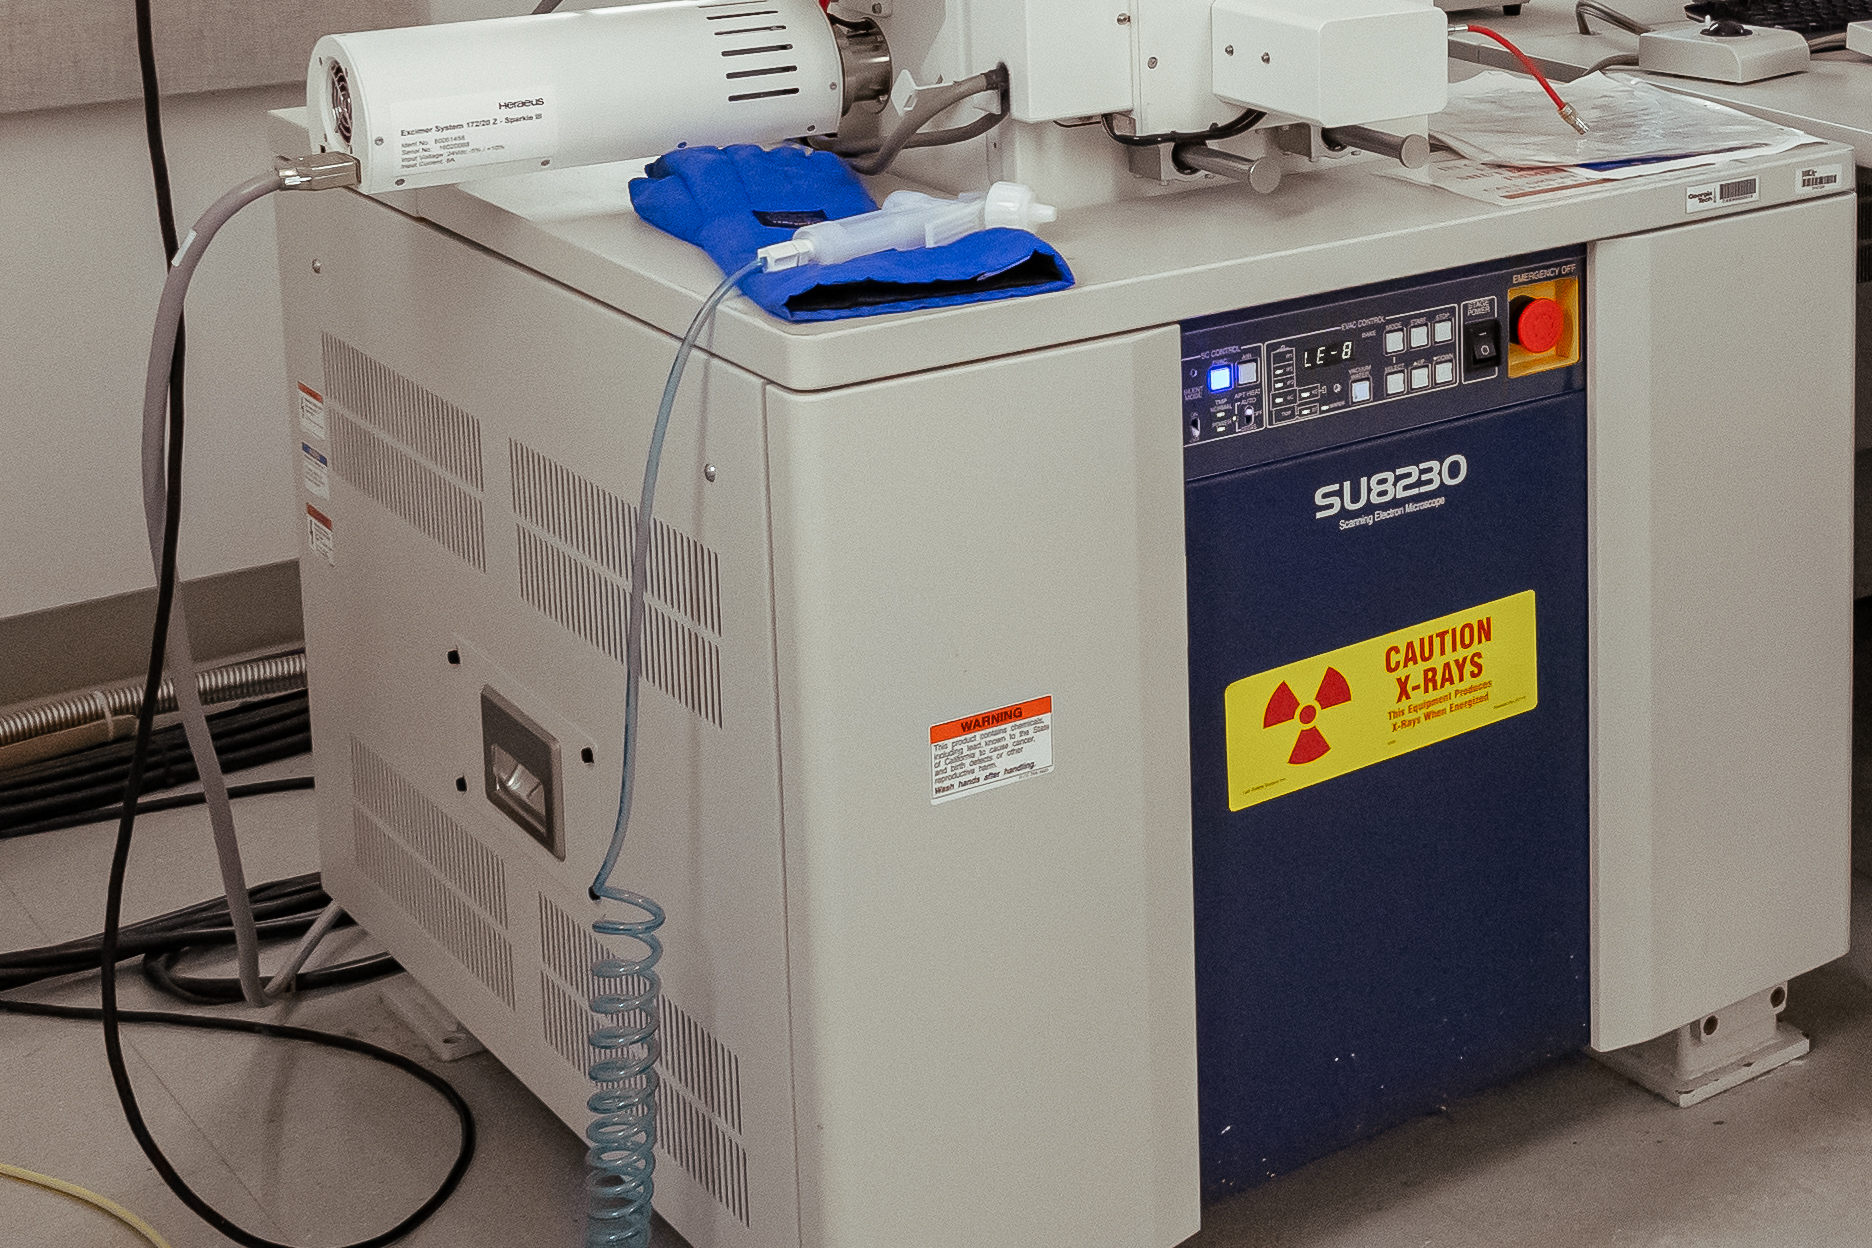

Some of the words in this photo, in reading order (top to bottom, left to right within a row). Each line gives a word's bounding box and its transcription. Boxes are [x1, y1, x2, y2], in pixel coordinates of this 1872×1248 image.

[498, 97, 544, 110] Heraeus
[400, 126, 433, 137] Excimer
[434, 122, 464, 133] System
[504, 114, 534, 124] Sparkle
[1688, 190, 1712, 200] Georgia
[1512, 268, 1560, 284] EMERGENCY
[1561, 264, 1576, 274] OFF
[1342, 321, 1356, 330] EVAC
[1358, 316, 1386, 327] CONTROL
[1467, 306, 1490, 316] POWER
[1200, 351, 1210, 360] SC
[1210, 346, 1241, 358] CONTROL
[1184, 392, 1202, 400] MODE
[1240, 397, 1256, 405] AUTO
[1314, 454, 1468, 520] SU8230
[1338, 515, 1374, 530] Scanning
[1374, 506, 1404, 522] Electron
[1405, 497, 1446, 514] Microscope
[1385, 616, 1492, 674] CAUTION
[1396, 652, 1484, 704] X-RAYS
[1388, 708, 1406, 720] This
[1408, 692, 1452, 714] Equipment
[1454, 680, 1492, 698] Produces
[1392, 716, 1421, 732] X-Rays
[1423, 708, 1446, 722] When
[1450, 692, 1489, 712] Energized
[961, 707, 1023, 732] WARNING
[934, 744, 948, 752] This
[952, 734, 976, 750] product
[980, 728, 1007, 740] contains
[934, 748, 964, 760] including
[984, 736, 1006, 747] known
[1019, 730, 1030, 738] the
[1032, 724, 1050, 734] State
[934, 760, 942, 768] of
[944, 753, 976, 766] California
[989, 744, 1008, 754] cause
[1012, 736, 1036, 747] cancer,
[934, 767, 948, 776] and
[950, 762, 966, 772] birth
[969, 756, 993, 767] defects
[1006, 746, 1024, 756] other
[934, 768, 975, 784] reproductive
[934, 782, 954, 794] Wash
[958, 776, 980, 788] hands
[984, 772, 1000, 781] after
[1004, 762, 1036, 776] handling.
